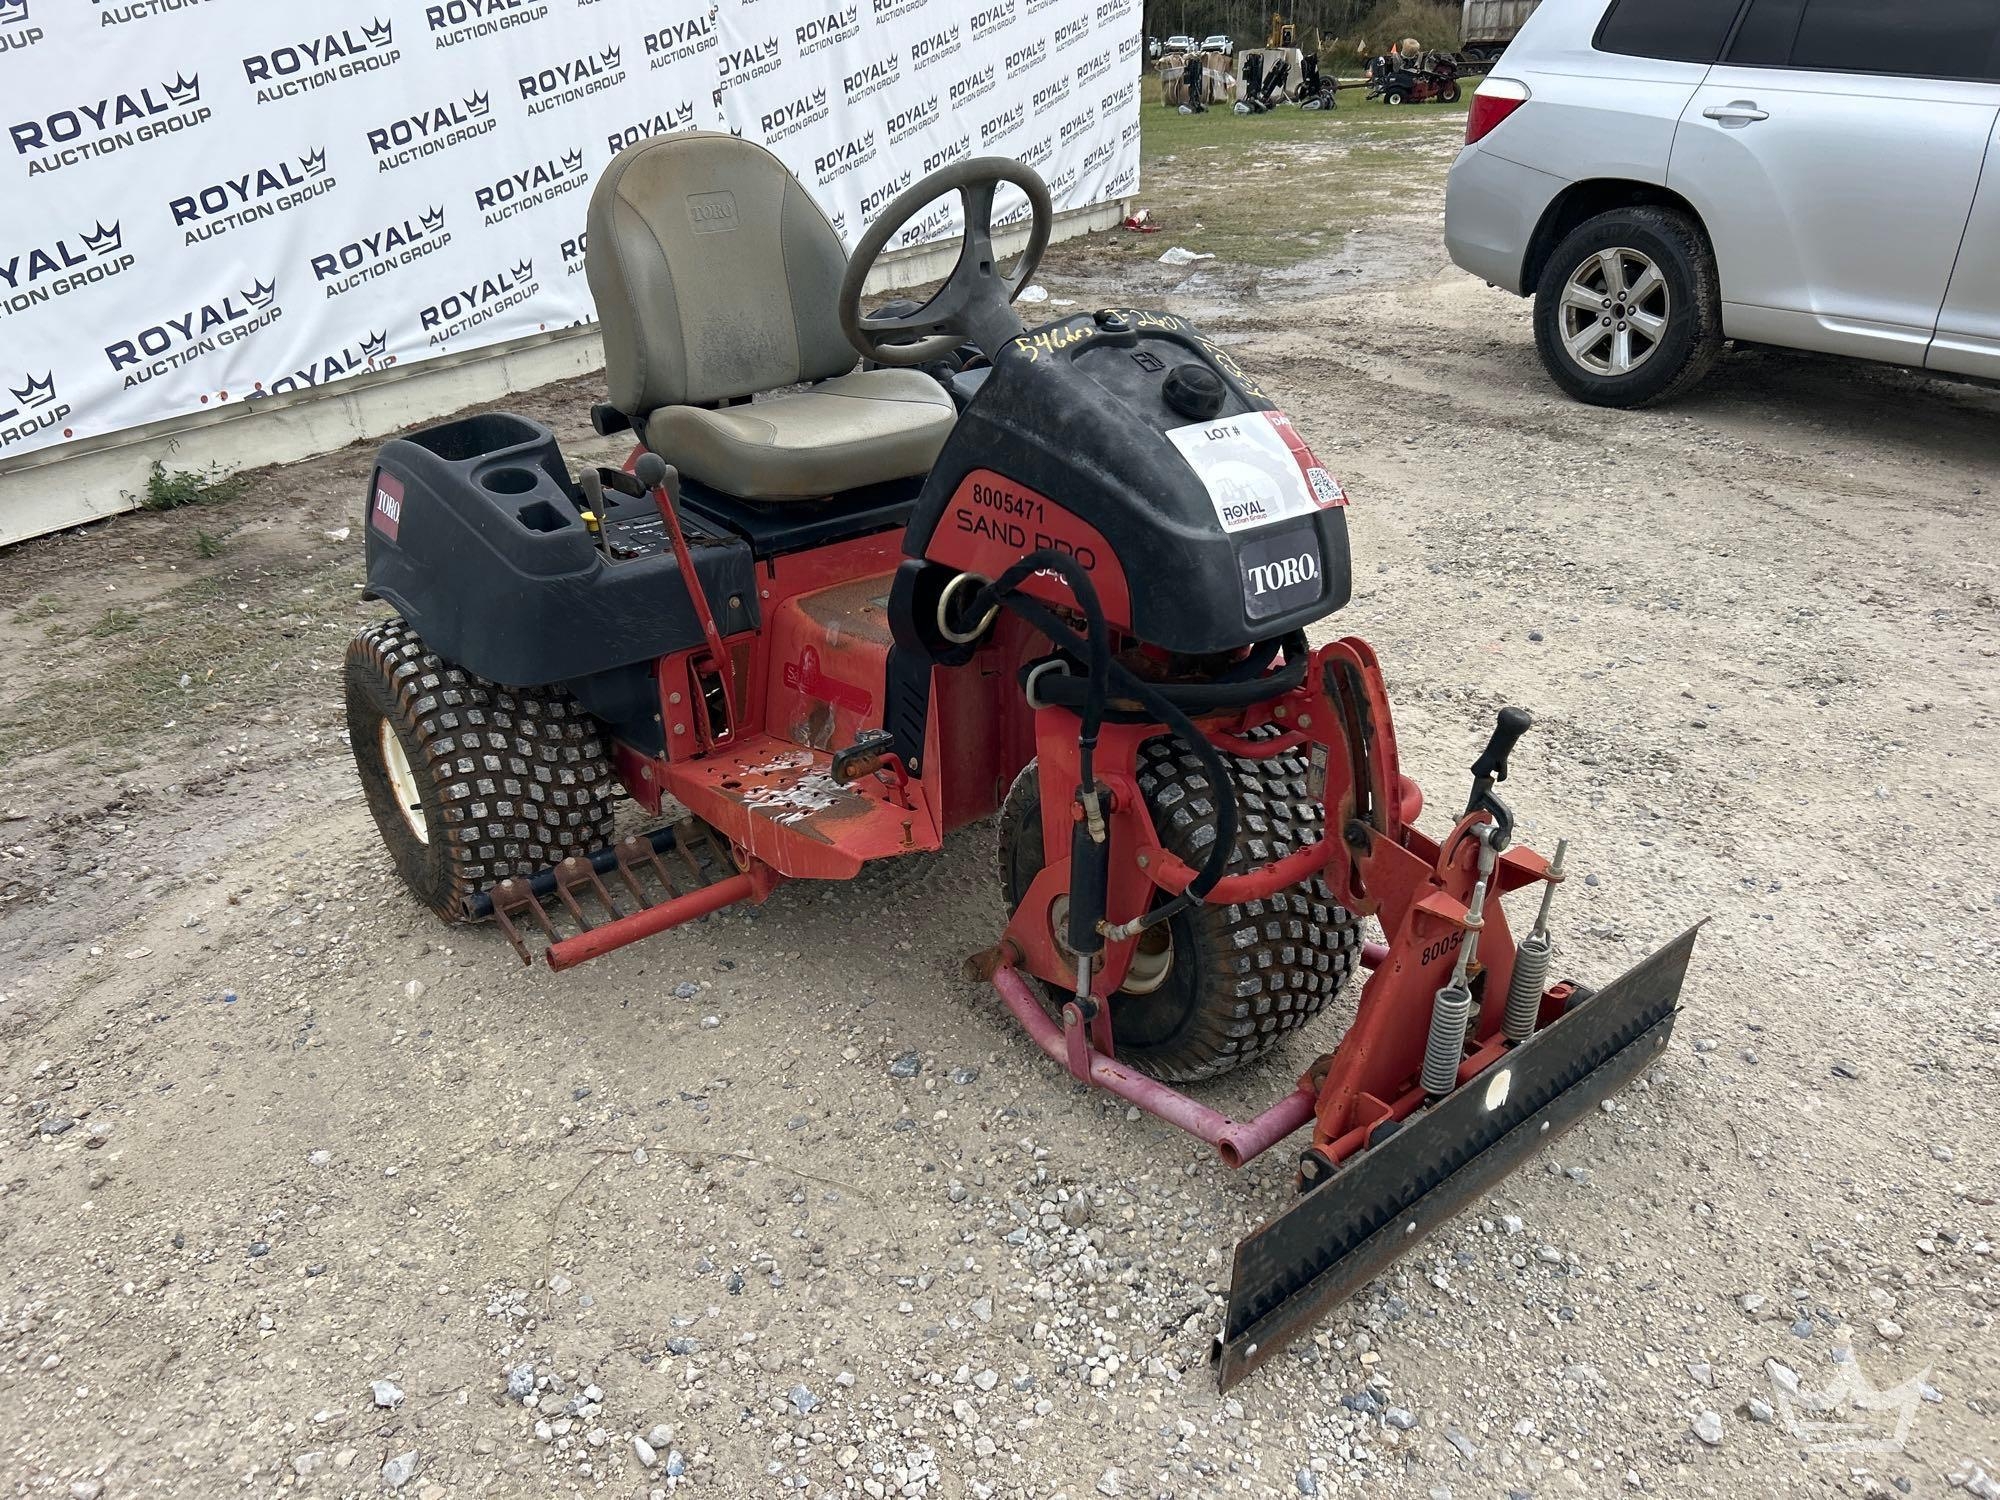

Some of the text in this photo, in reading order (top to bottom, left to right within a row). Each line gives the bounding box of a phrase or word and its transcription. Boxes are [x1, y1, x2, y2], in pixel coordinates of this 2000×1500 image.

[876, 6, 905, 25] AUCTION
[970, 4, 1006, 31] ROYAL
[1096, 0, 1123, 20] ROYAL
[435, 6, 549, 50] AUCTION GROUP
[644, 16, 711, 55] ROYAL
[796, 12, 847, 45] ROYAL
[800, 25, 860, 58] AUCTION GROUP
[912, 31, 950, 60] ROYAL
[972, 15, 1017, 41] AUCTION GROUP
[1054, 19, 1082, 43] ROYAL
[243, 30, 367, 84] ROYAL
[650, 35, 718, 71] AUCTION GRO
[719, 45, 765, 76] OYAL
[914, 42, 961, 71] AUCTION GROUP
[1005, 43, 1038, 70] ROYAL
[1077, 55, 1104, 79] ROYAL
[256, 50, 401, 105] AUCTION GROUP
[518, 55, 603, 100] ROYAL
[720, 59, 782, 91] CTION GROUP
[843, 61, 887, 94] ROYAL
[847, 72, 900, 105] AUCTION GROUP
[950, 71, 985, 100] ROYAL
[527, 71, 626, 117] AUCTION GROUP
[952, 81, 996, 110] AUCTION GROUP
[1033, 80, 1062, 107] ROYAL
[1101, 87, 1127, 111] ROYAL
[9, 88, 169, 155] ROYAL
[367, 102, 468, 155] ROYAL
[762, 96, 814, 133] ROYAL
[766, 107, 829, 146] AUCTION GROUP
[887, 102, 928, 135] ROYAL
[890, 112, 940, 146] AUCTION GROUP
[981, 109, 1016, 139] ROYAL
[1060, 112, 1087, 140] ROYAL
[1122, 120, 1139, 141] ROYA
[28, 107, 212, 177] AUCTION GROUP
[378, 118, 497, 173] AUCTION GROUP
[608, 111, 678, 154] ROYAL
[815, 139, 864, 174] ROYAL
[818, 148, 877, 187] AUCTION GROUP
[924, 141, 961, 174] ROYAL
[1083, 143, 1109, 169] ROYAL
[169, 162, 304, 227] ROYAL
[475, 160, 563, 211] ROYAL
[860, 179, 902, 214] ROYAL
[1047, 173, 1068, 191] OYAL
[1105, 170, 1130, 195] ROYAL
[184, 177, 337, 247] AUCTION GROUP
[484, 173, 588, 227] AUCTION GROUP
[902, 212, 941, 247] ROYAL
[0, 240, 87, 288] YAL
[311, 220, 423, 281] ROYAL
[326, 232, 452, 298] AUCTION GROUP
[52, 254, 135, 296] GROUP
[420, 272, 514, 331] ROYAL
[429, 283, 540, 347] AUCTION GROUP
[105, 296, 248, 372] ROYAL
[123, 306, 283, 390] AUCTION GROUP
[0, 403, 72, 447] ROUP
[1205, 425, 1241, 441] LOT #
[973, 484, 1044, 524] 8005471
[1222, 500, 1265, 520] ROYAL
[957, 509, 1025, 548] SAND
